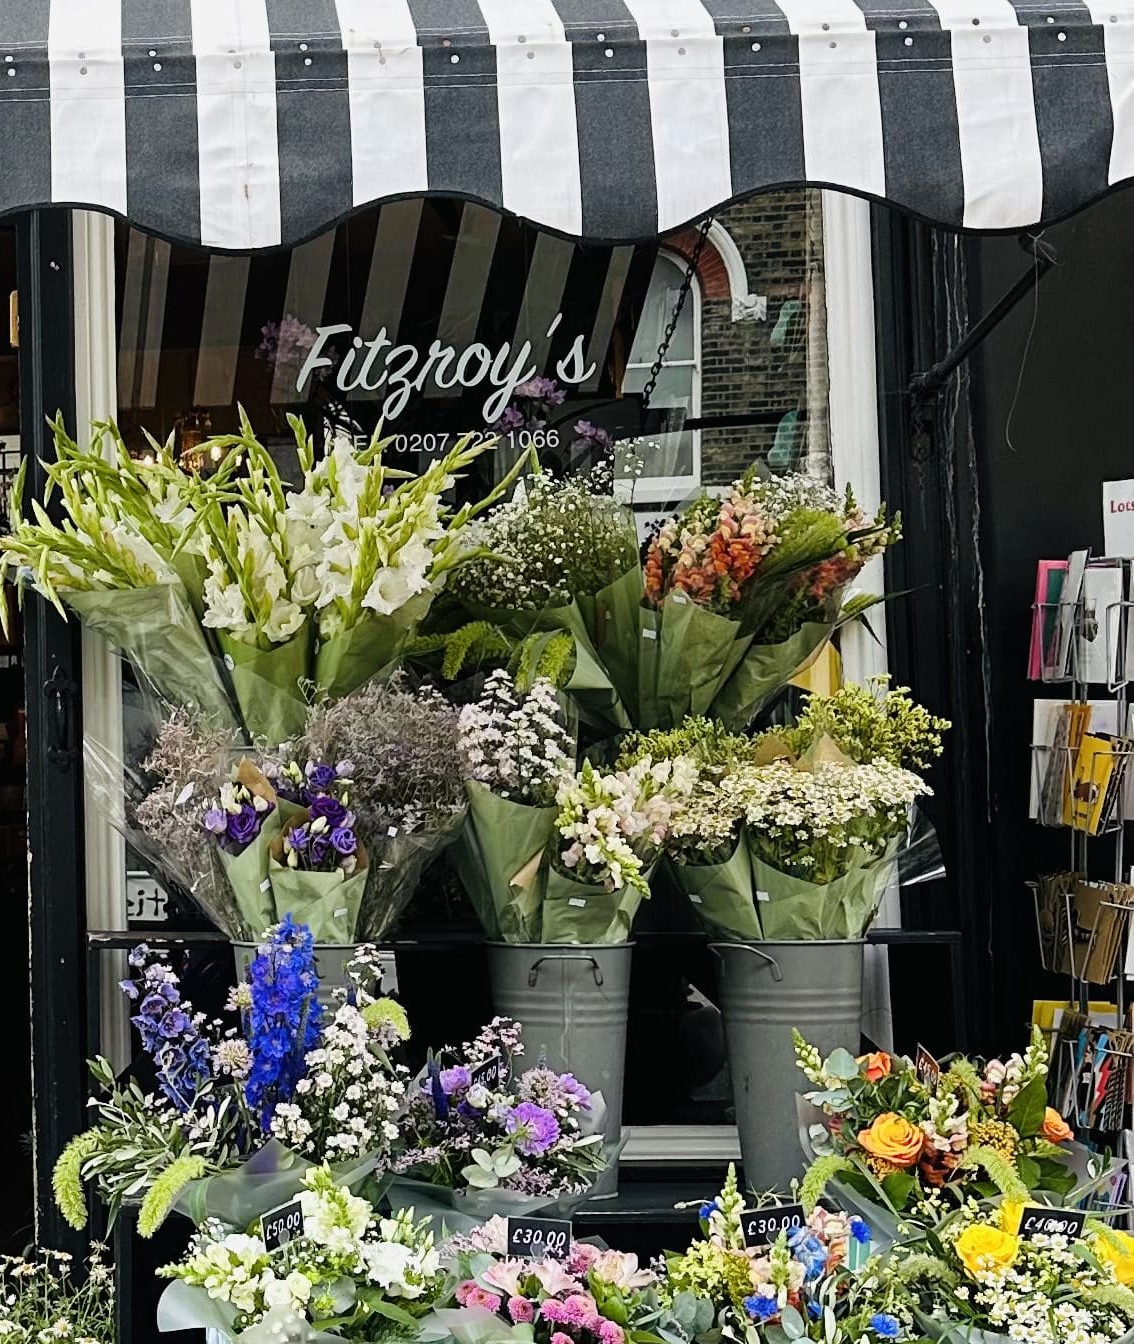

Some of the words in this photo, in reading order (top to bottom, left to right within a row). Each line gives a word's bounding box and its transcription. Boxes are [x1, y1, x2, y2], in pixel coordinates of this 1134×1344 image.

[296, 313, 597, 422] Fitzroy's
[395, 432, 447, 453] 0207
[506, 429, 560, 449] 1066
[747, 1214, 801, 1236] £30.00
[512, 1228, 566, 1247] £30.00
